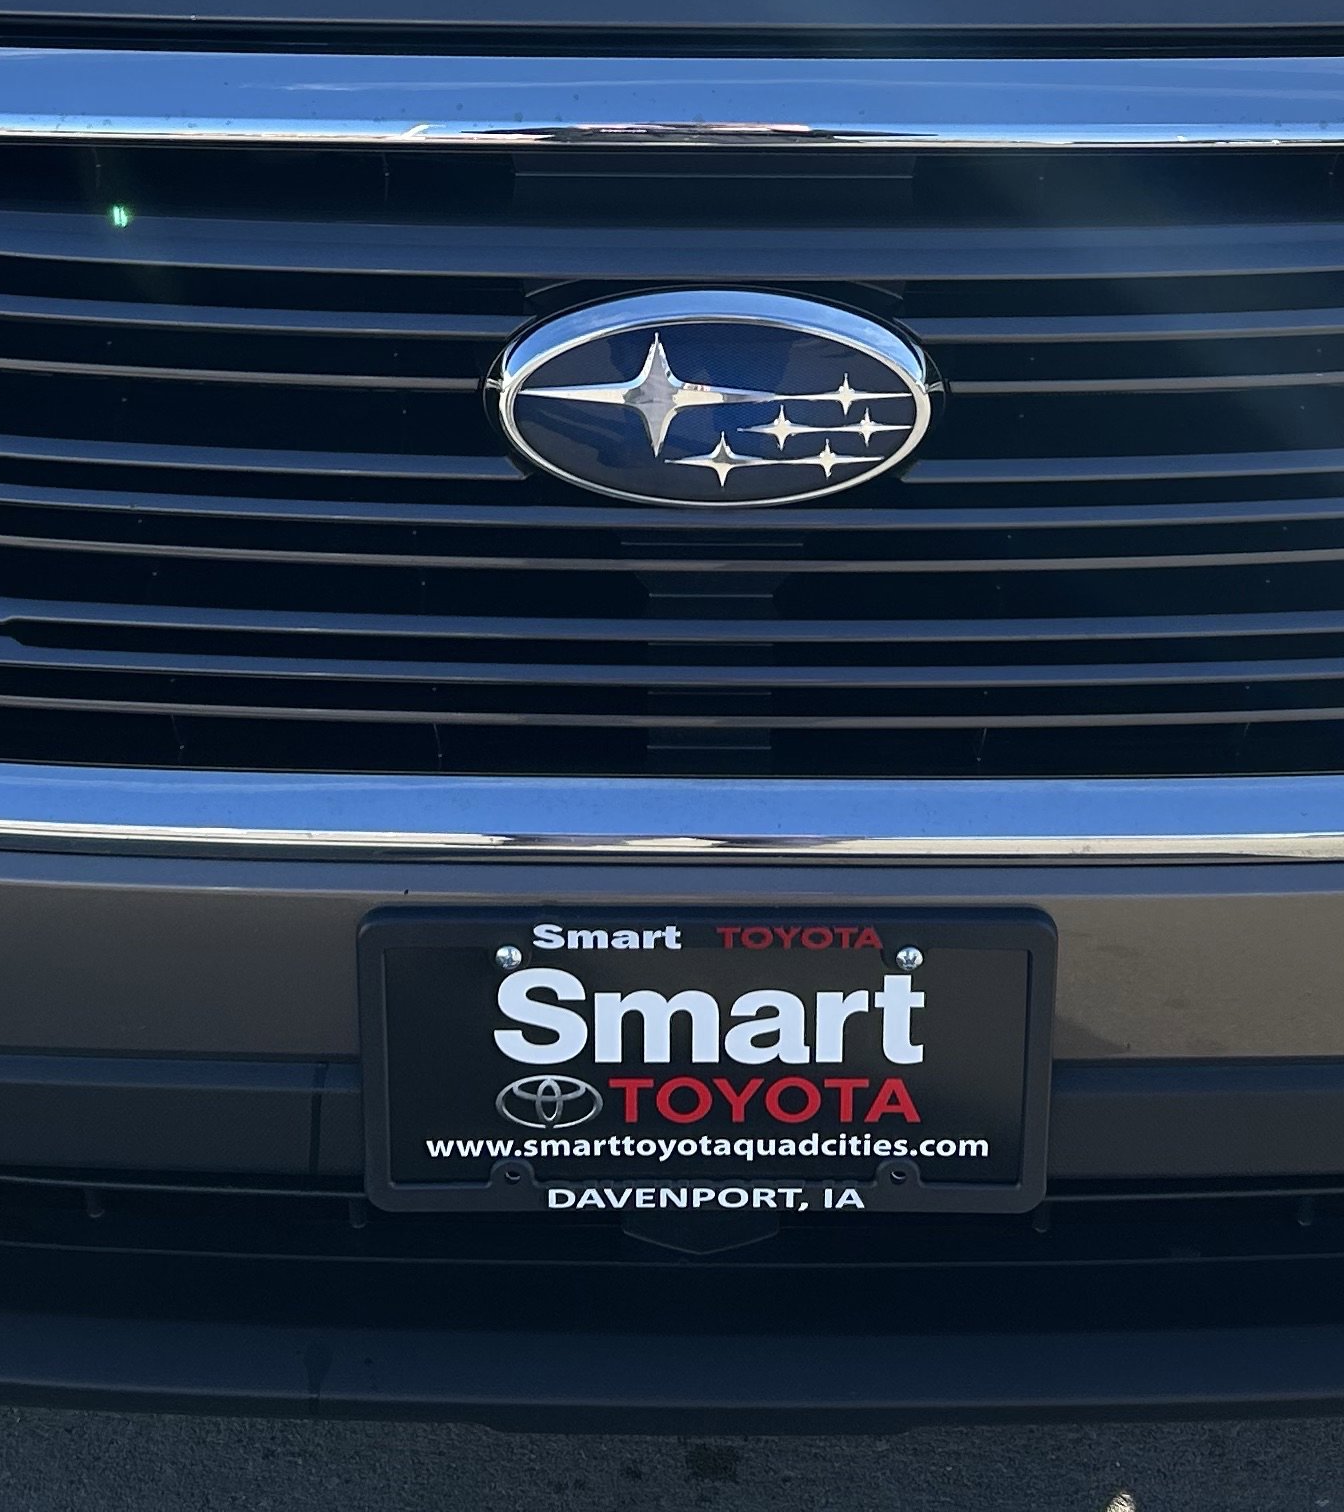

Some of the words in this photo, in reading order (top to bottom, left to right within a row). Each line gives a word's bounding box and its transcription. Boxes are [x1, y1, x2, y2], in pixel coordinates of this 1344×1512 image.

[532, 923, 682, 950] Smart
[716, 926, 884, 950] TOYOTA
[493, 967, 925, 1065] Smart
[607, 1076, 922, 1124] TOYOTA
[425, 1132, 989, 1162] www.smarttoyotaquadcities.com
[548, 1187, 810, 1212] DAVENPORT,
[823, 1188, 865, 1209] IA
